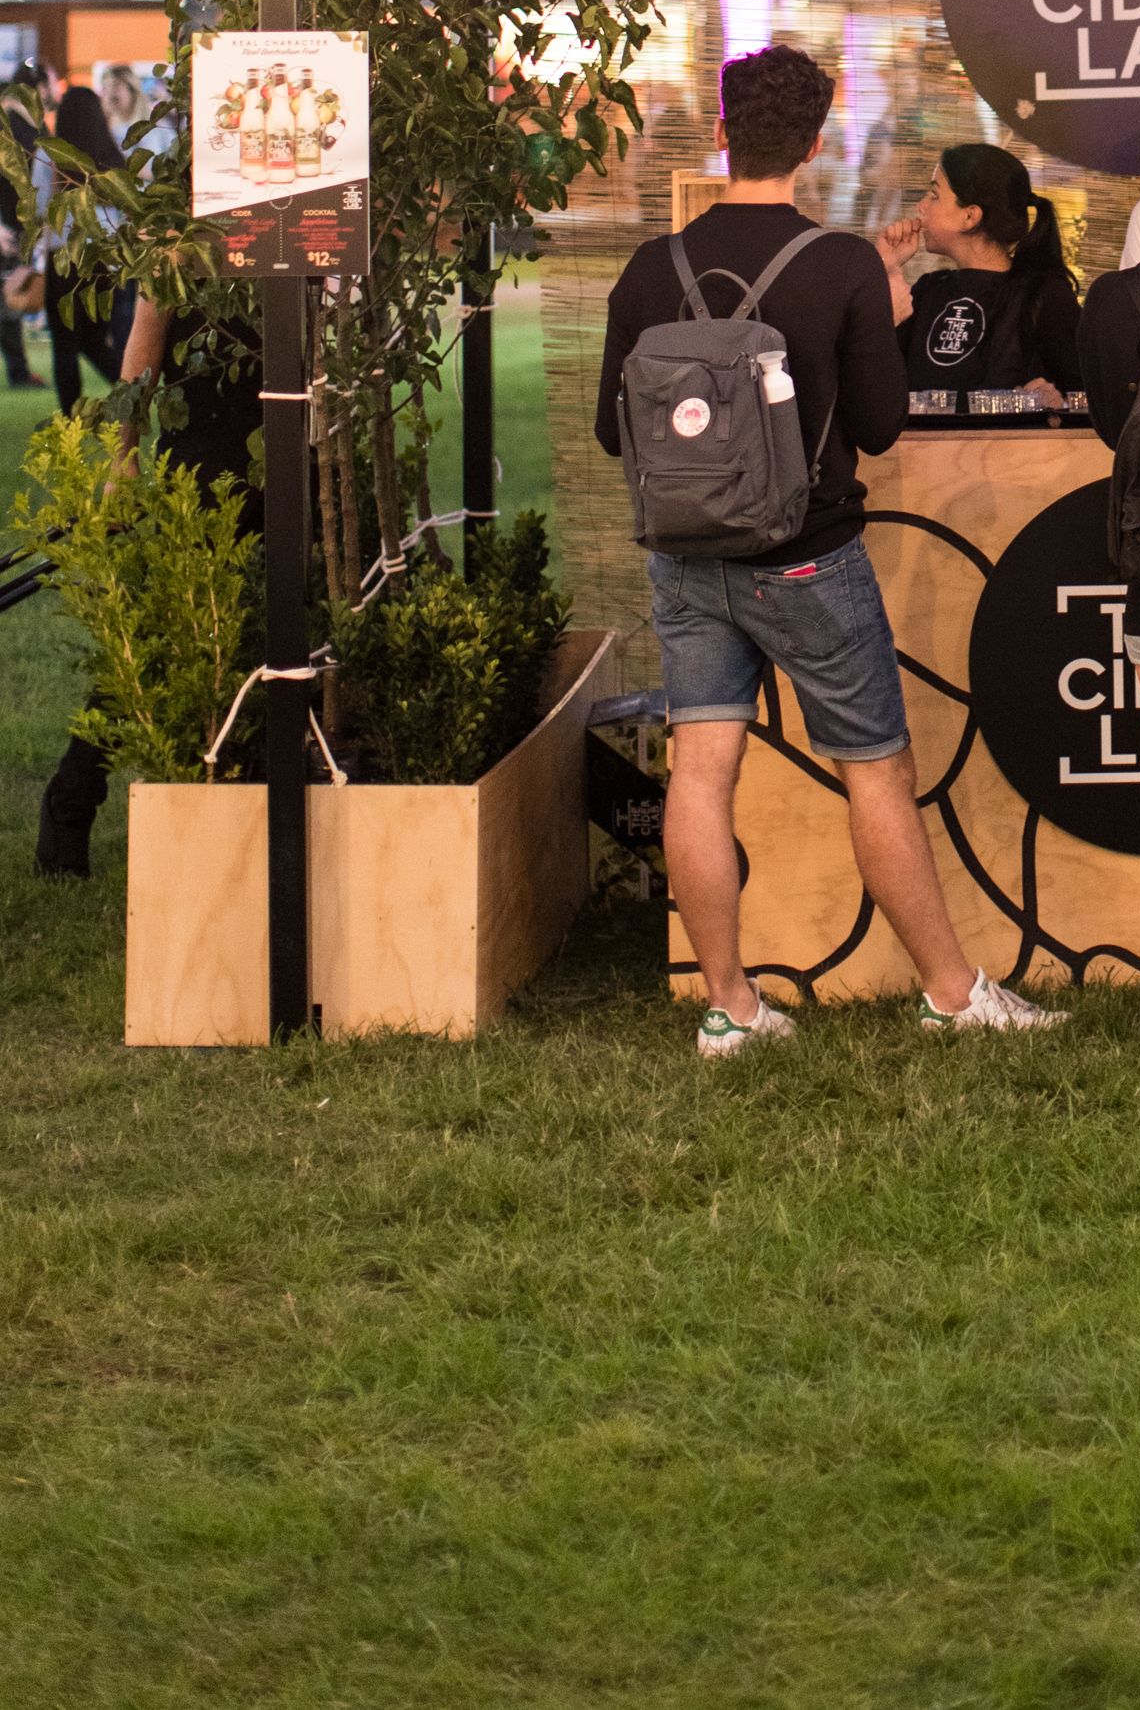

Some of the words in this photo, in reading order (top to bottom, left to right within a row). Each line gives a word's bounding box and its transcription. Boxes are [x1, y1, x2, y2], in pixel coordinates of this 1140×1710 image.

[231, 39, 260, 47] REAL
[264, 39, 329, 47] CHARACTER
[231, 209, 253, 217] CIDER
[303, 209, 338, 217] COCKTAIL
[228, 251, 245, 267] $8
[307, 251, 331, 267] $12
[947, 320, 967, 332] THE
[939, 330, 969, 342] CIDER
[940, 340, 961, 351] LAB
[631, 805, 641, 829] THE
[641, 801, 651, 836] CIDER
